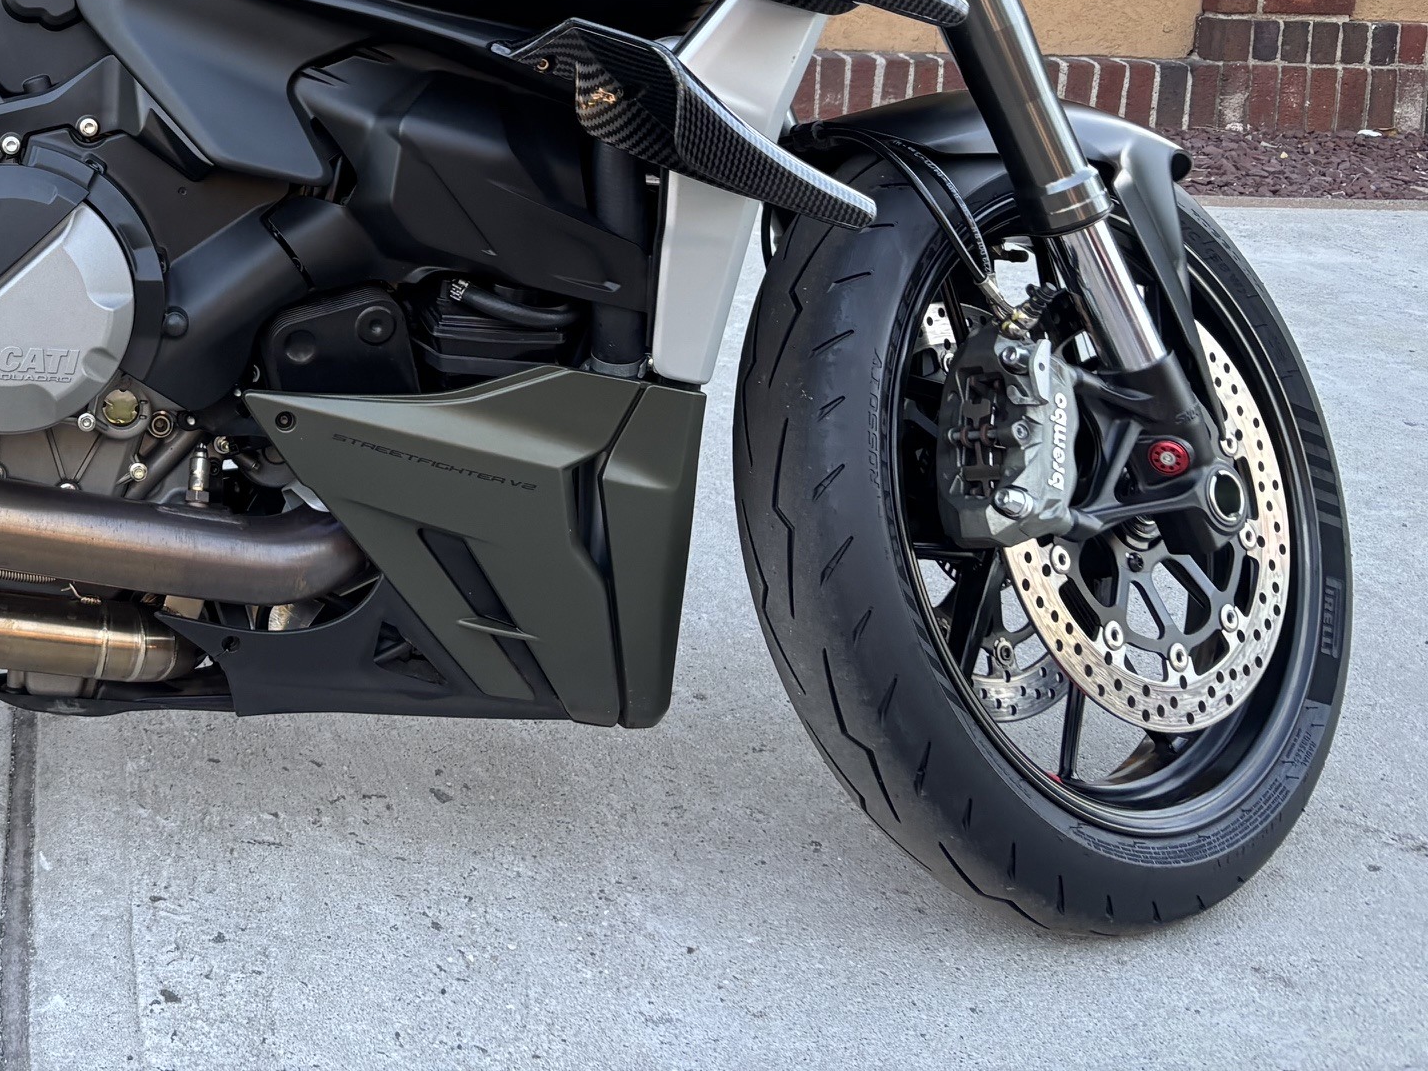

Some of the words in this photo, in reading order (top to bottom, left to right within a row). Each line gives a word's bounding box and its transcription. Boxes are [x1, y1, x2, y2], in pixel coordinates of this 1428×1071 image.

[332, 433, 506, 484] STREETFIGHTER
[510, 478, 538, 491] V2
[868, 392, 880, 489] ROSSO
[1047, 392, 1067, 490] brembo
[1320, 576, 1346, 659] PIRELLI
